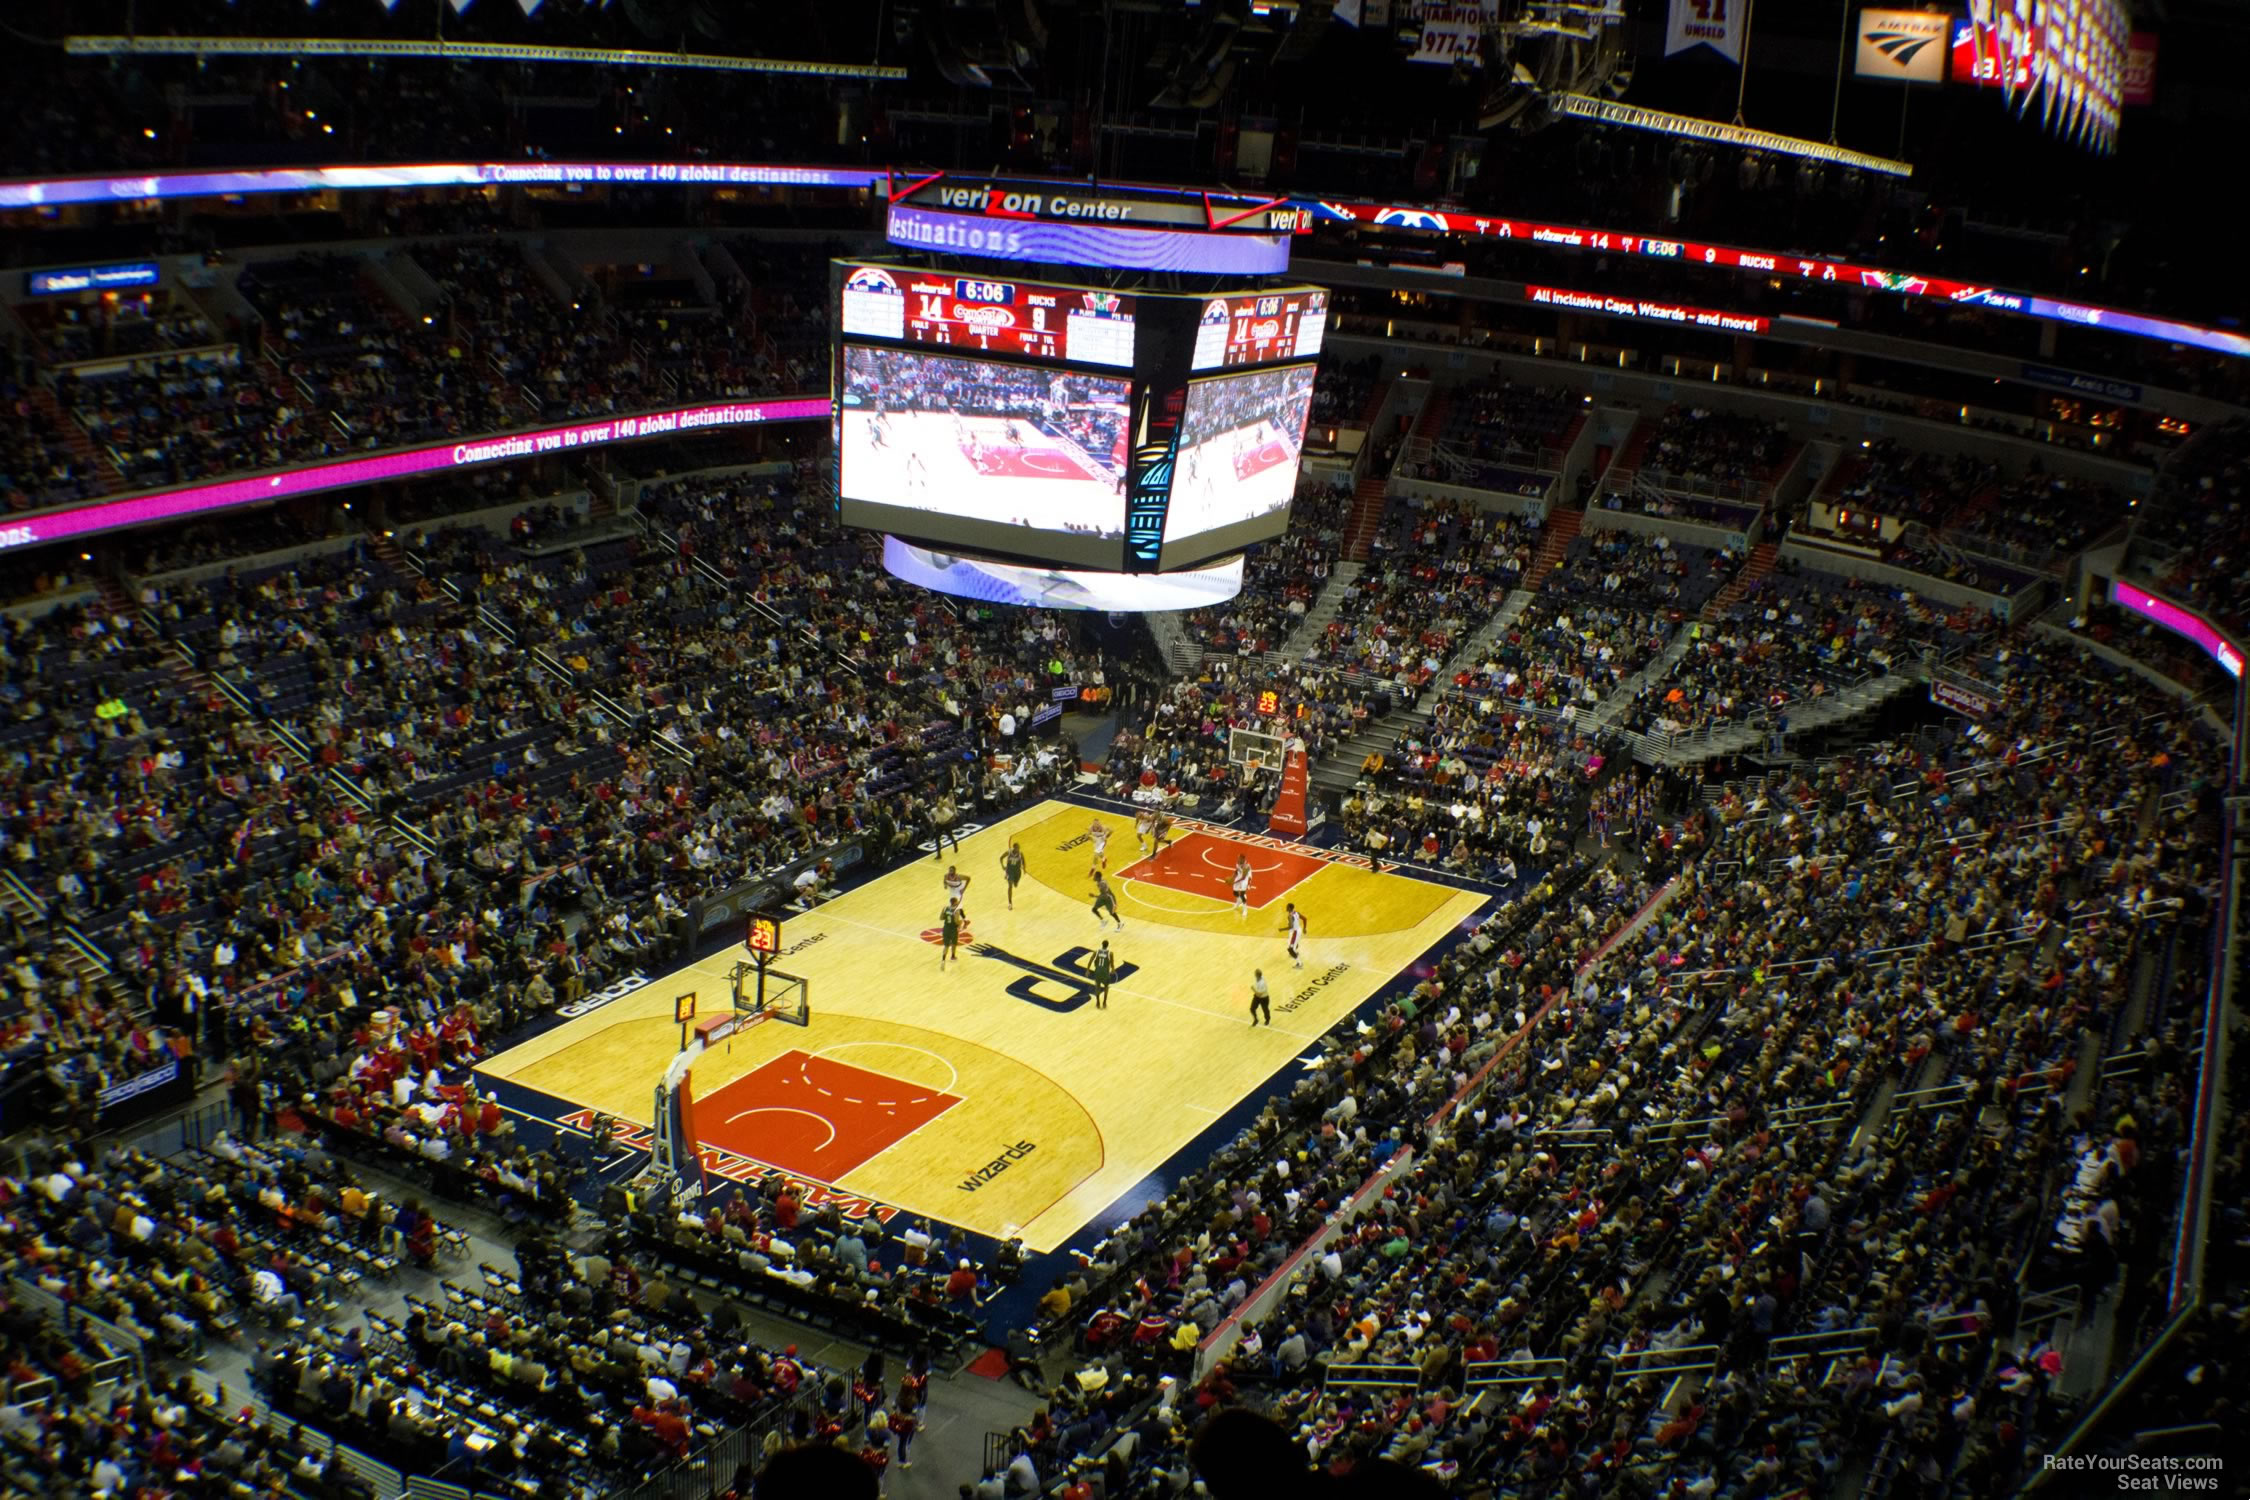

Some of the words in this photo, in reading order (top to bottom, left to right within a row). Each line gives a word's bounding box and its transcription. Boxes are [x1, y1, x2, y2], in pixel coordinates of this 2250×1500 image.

[495, 164, 562, 181] Connecting
[566, 166, 593, 181] you
[597, 165, 612, 180] to
[615, 166, 647, 181] over
[651, 164, 677, 180] 140
[680, 165, 725, 181] global
[730, 166, 836, 184] destinations.
[940, 184, 1042, 218] verizon
[1050, 196, 1132, 224] Center
[888, 210, 1033, 254] destinations.
[1590, 233, 1609, 249] 14
[1647, 240, 1677, 256] 6:06
[1705, 248, 1717, 263] 9
[1739, 254, 1776, 270] BUCKS
[966, 282, 1004, 303] 6:06
[1028, 295, 1056, 307] BUCKS
[920, 294, 942, 321] 14
[1033, 307, 1046, 330] 9
[1533, 288, 1550, 304] All
[1604, 298, 1636, 316] Caps,
[1638, 302, 1685, 322] Wizards
[1696, 312, 1719, 327] and
[1720, 317, 1758, 333] more!
[453, 436, 533, 464] Connecting
[537, 435, 561, 452] you
[565, 431, 578, 446] to
[581, 426, 610, 444] over
[614, 419, 637, 439] 140
[639, 412, 677, 435] global
[680, 405, 766, 429] destinations.
[1259, 699, 1277, 713] 23
[751, 927, 771, 948] 23
[555, 975, 649, 1018] GEICO
[1273, 986, 1321, 1013] Verizon
[1311, 962, 1351, 987] Center
[956, 1139, 1036, 1192] wizards
